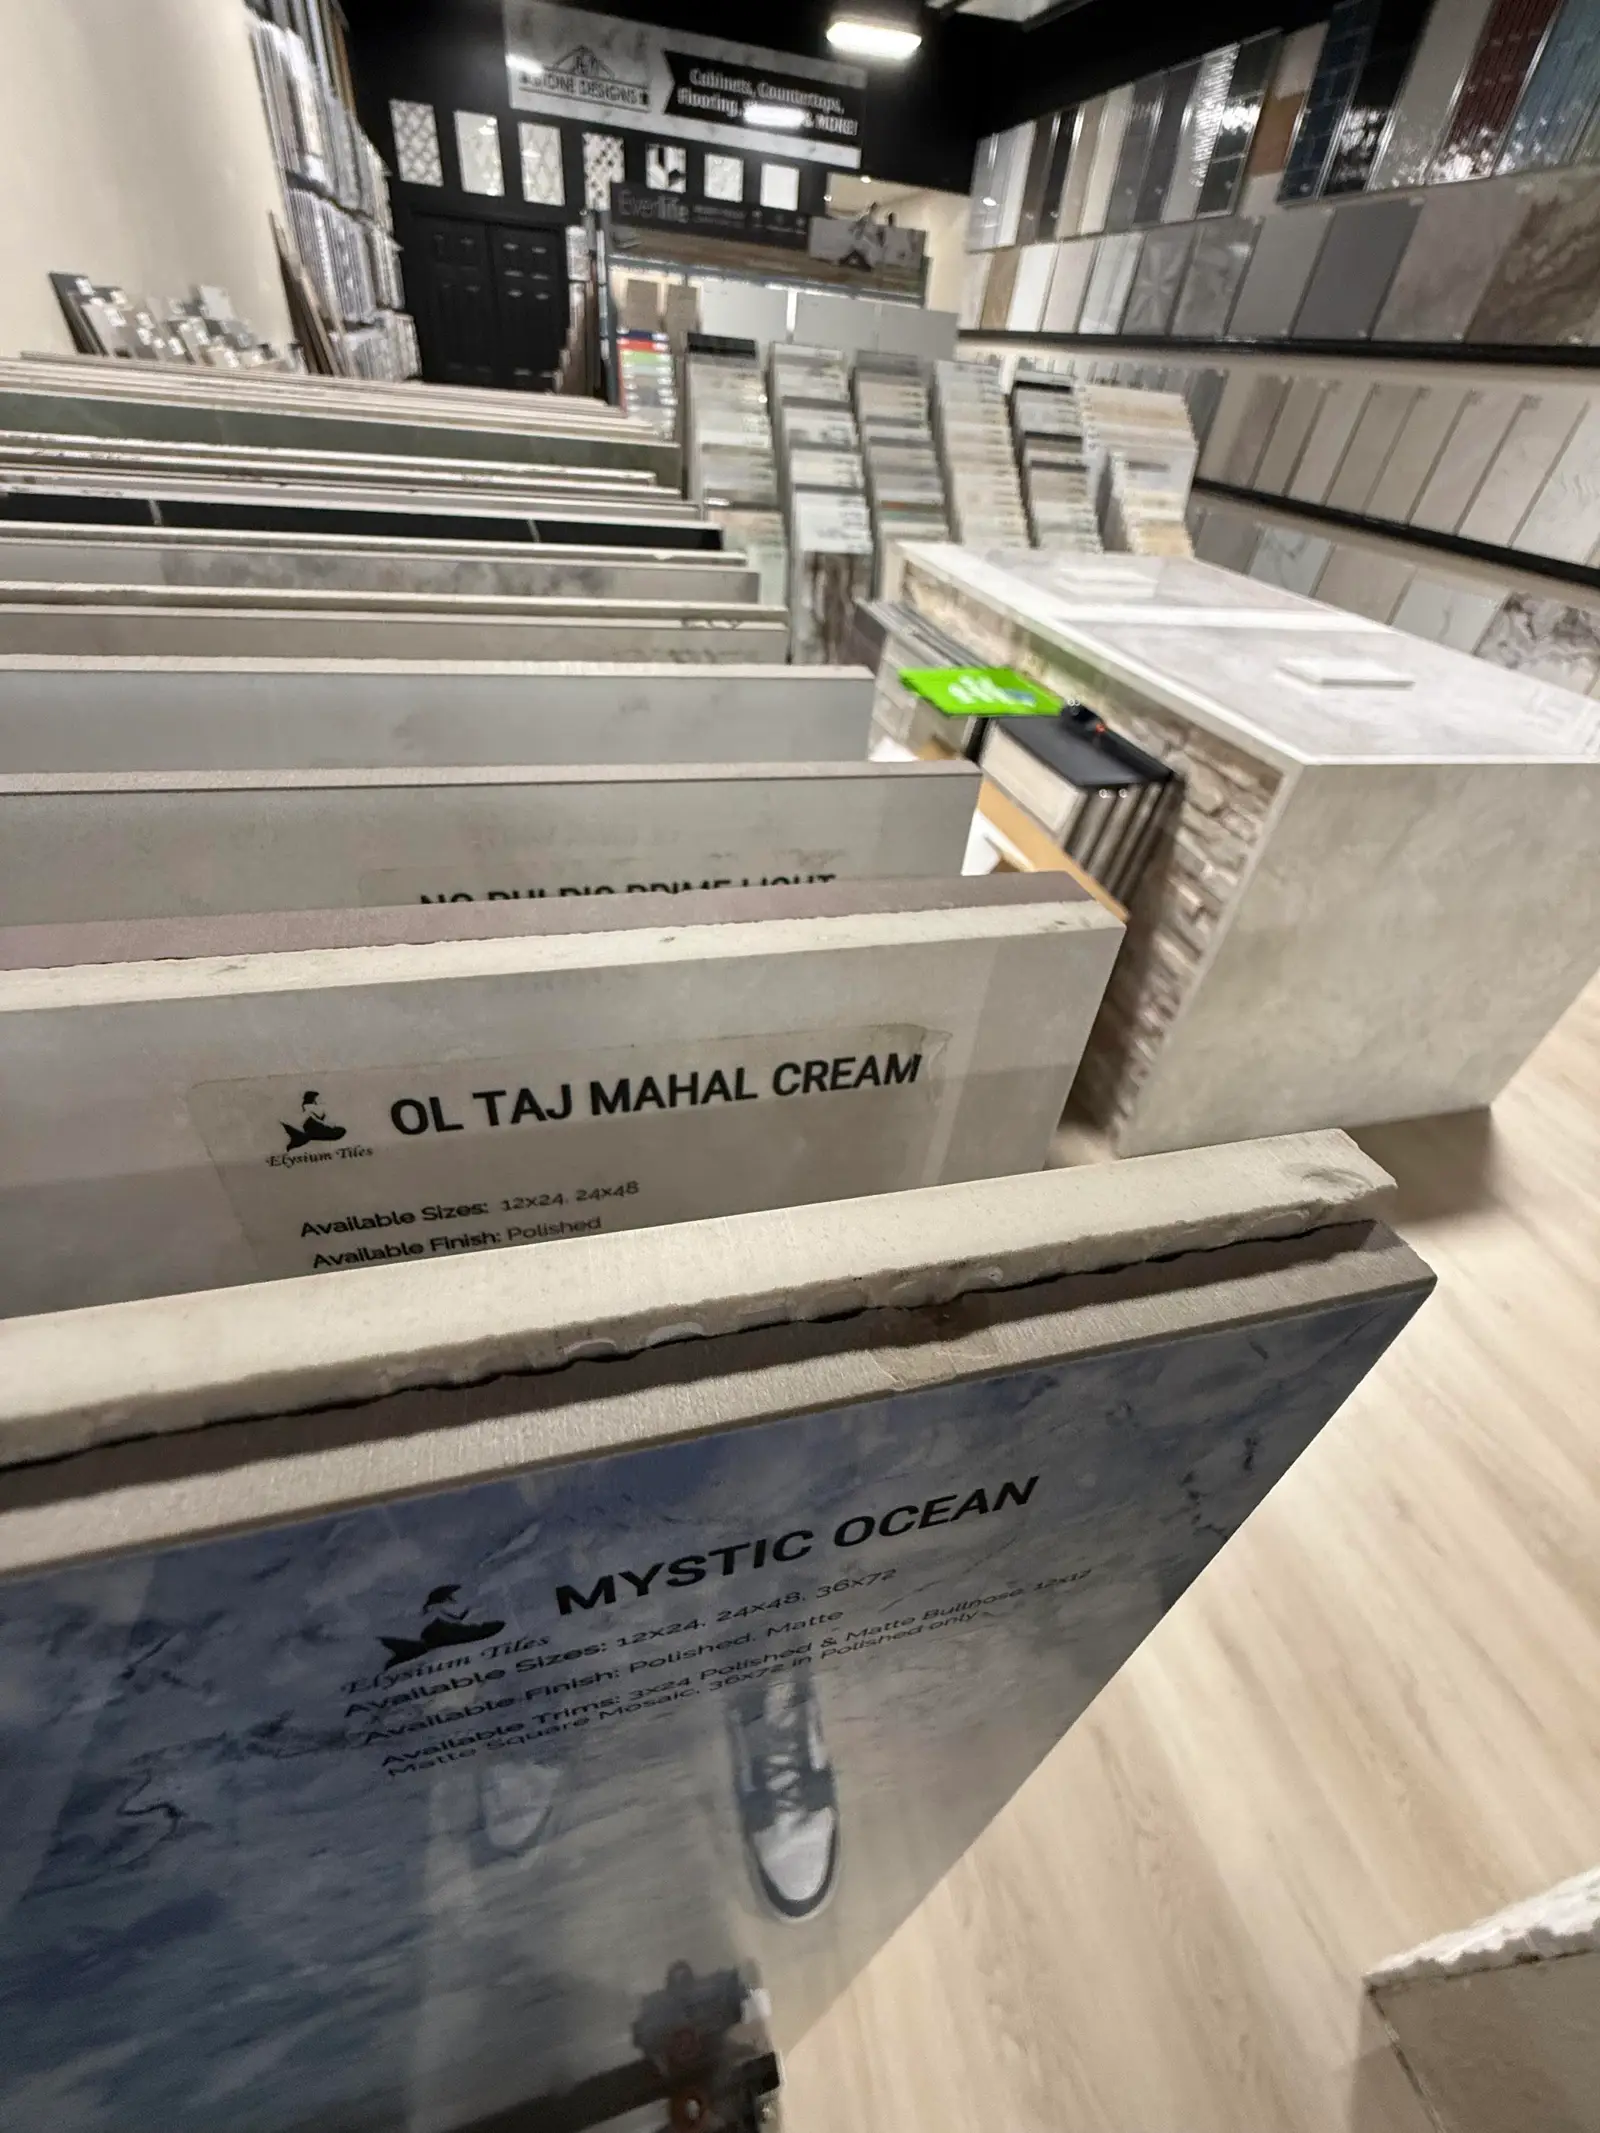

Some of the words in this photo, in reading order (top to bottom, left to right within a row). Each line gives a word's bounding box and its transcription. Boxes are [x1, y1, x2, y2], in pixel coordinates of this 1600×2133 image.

[390, 1098, 464, 1135] OL
[472, 1084, 572, 1126] TAJ
[590, 1068, 758, 1116] MAHAL
[773, 1053, 922, 1097] CREAM
[265, 1151, 333, 1169] Elysium
[336, 1145, 373, 1160] Tiles
[301, 1211, 416, 1238] Available
[421, 1202, 490, 1222] Sizes:
[576, 1180, 640, 1202] 24x48
[313, 1242, 424, 1269] Available
[430, 1231, 502, 1252] Finish:
[507, 1216, 602, 1241] Polished
[555, 1529, 813, 1616] MYSTIC
[833, 1475, 1040, 1547] OCEAN
[340, 1654, 472, 1694] Elysium
[480, 1634, 550, 1659] Tiles
[344, 1669, 506, 1718] Available
[515, 1642, 608, 1673] Sizes:
[816, 1568, 897, 1599] 36x72
[365, 1697, 515, 1746] Available
[525, 1669, 620, 1700] Finish:
[767, 1611, 844, 1637] Matte
[382, 1721, 525, 1767] Available
[532, 1695, 620, 1723] Trims:
[628, 1677, 691, 1699] 3x24
[700, 1642, 812, 1681] Polished
[820, 1636, 838, 1649] &
[846, 1616, 916, 1642] Matte
[922, 1588, 1024, 1621] Bullnose
[388, 1748, 476, 1776] Matte
[486, 1716, 590, 1750] Square
[709, 1662, 786, 1692] 36x72
[792, 1654, 812, 1668] in
[820, 1626, 922, 1660] Polished
[929, 1611, 979, 1631] only
